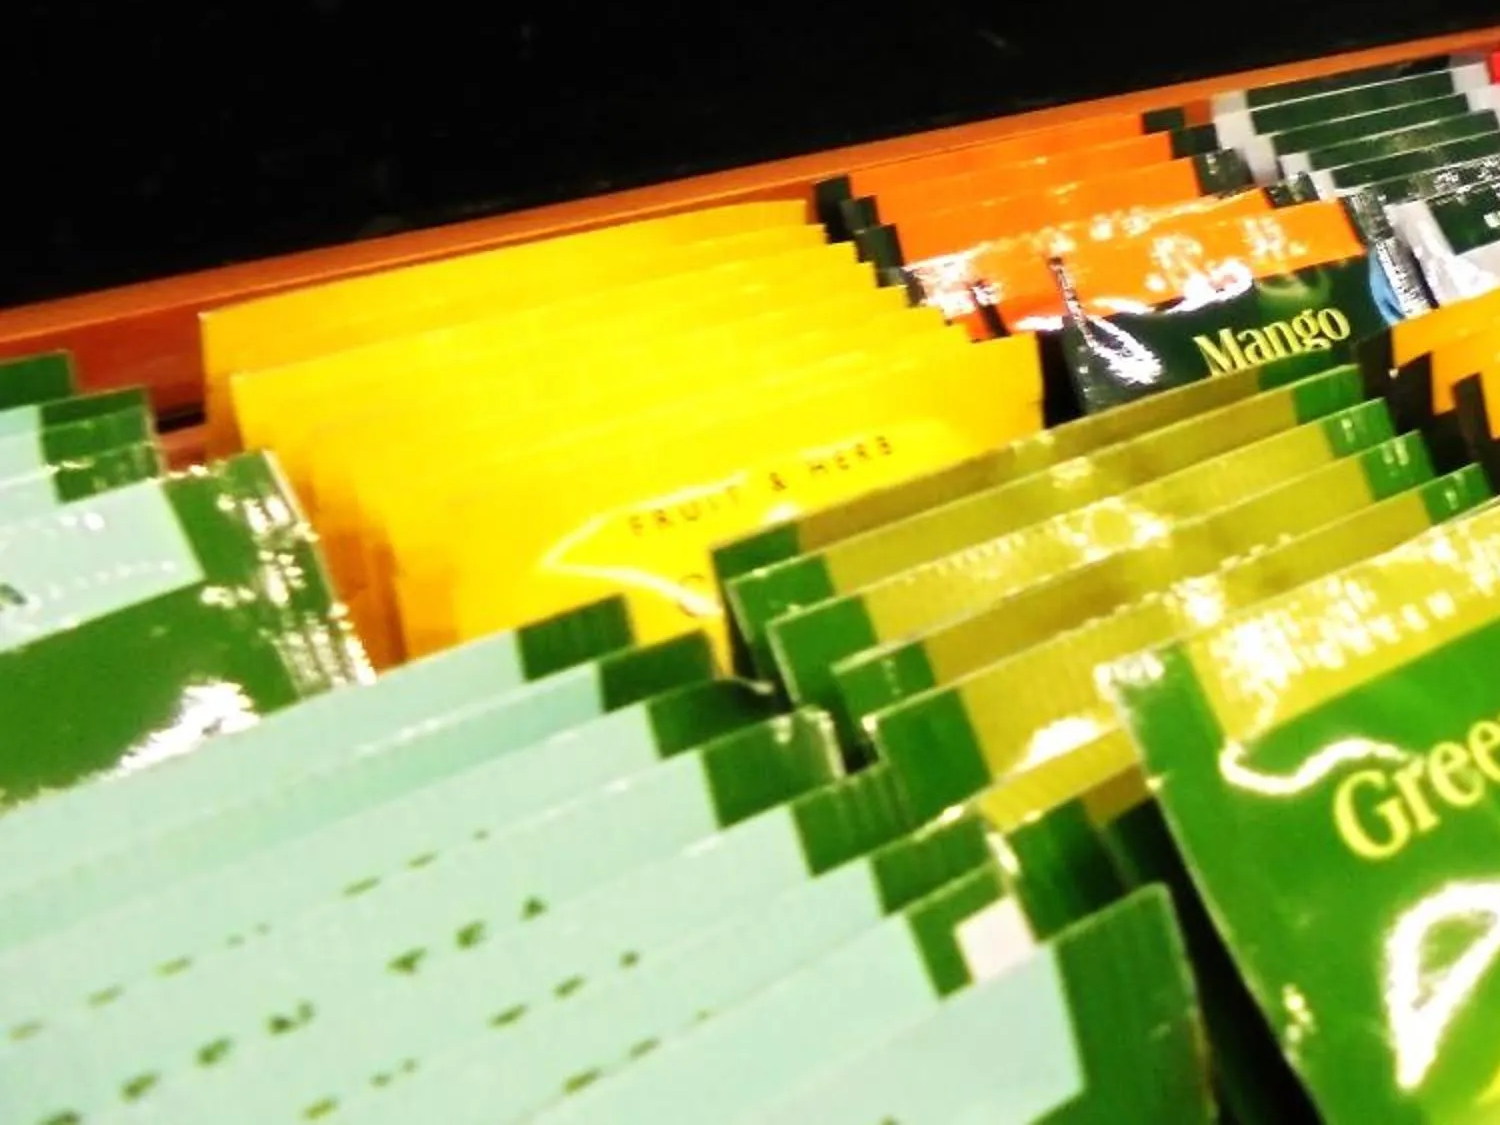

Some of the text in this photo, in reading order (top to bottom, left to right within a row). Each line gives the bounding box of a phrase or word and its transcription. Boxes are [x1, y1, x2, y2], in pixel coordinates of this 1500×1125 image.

[1192, 307, 1351, 378] Mango
[628, 435, 893, 536] FRUIT & HERB
